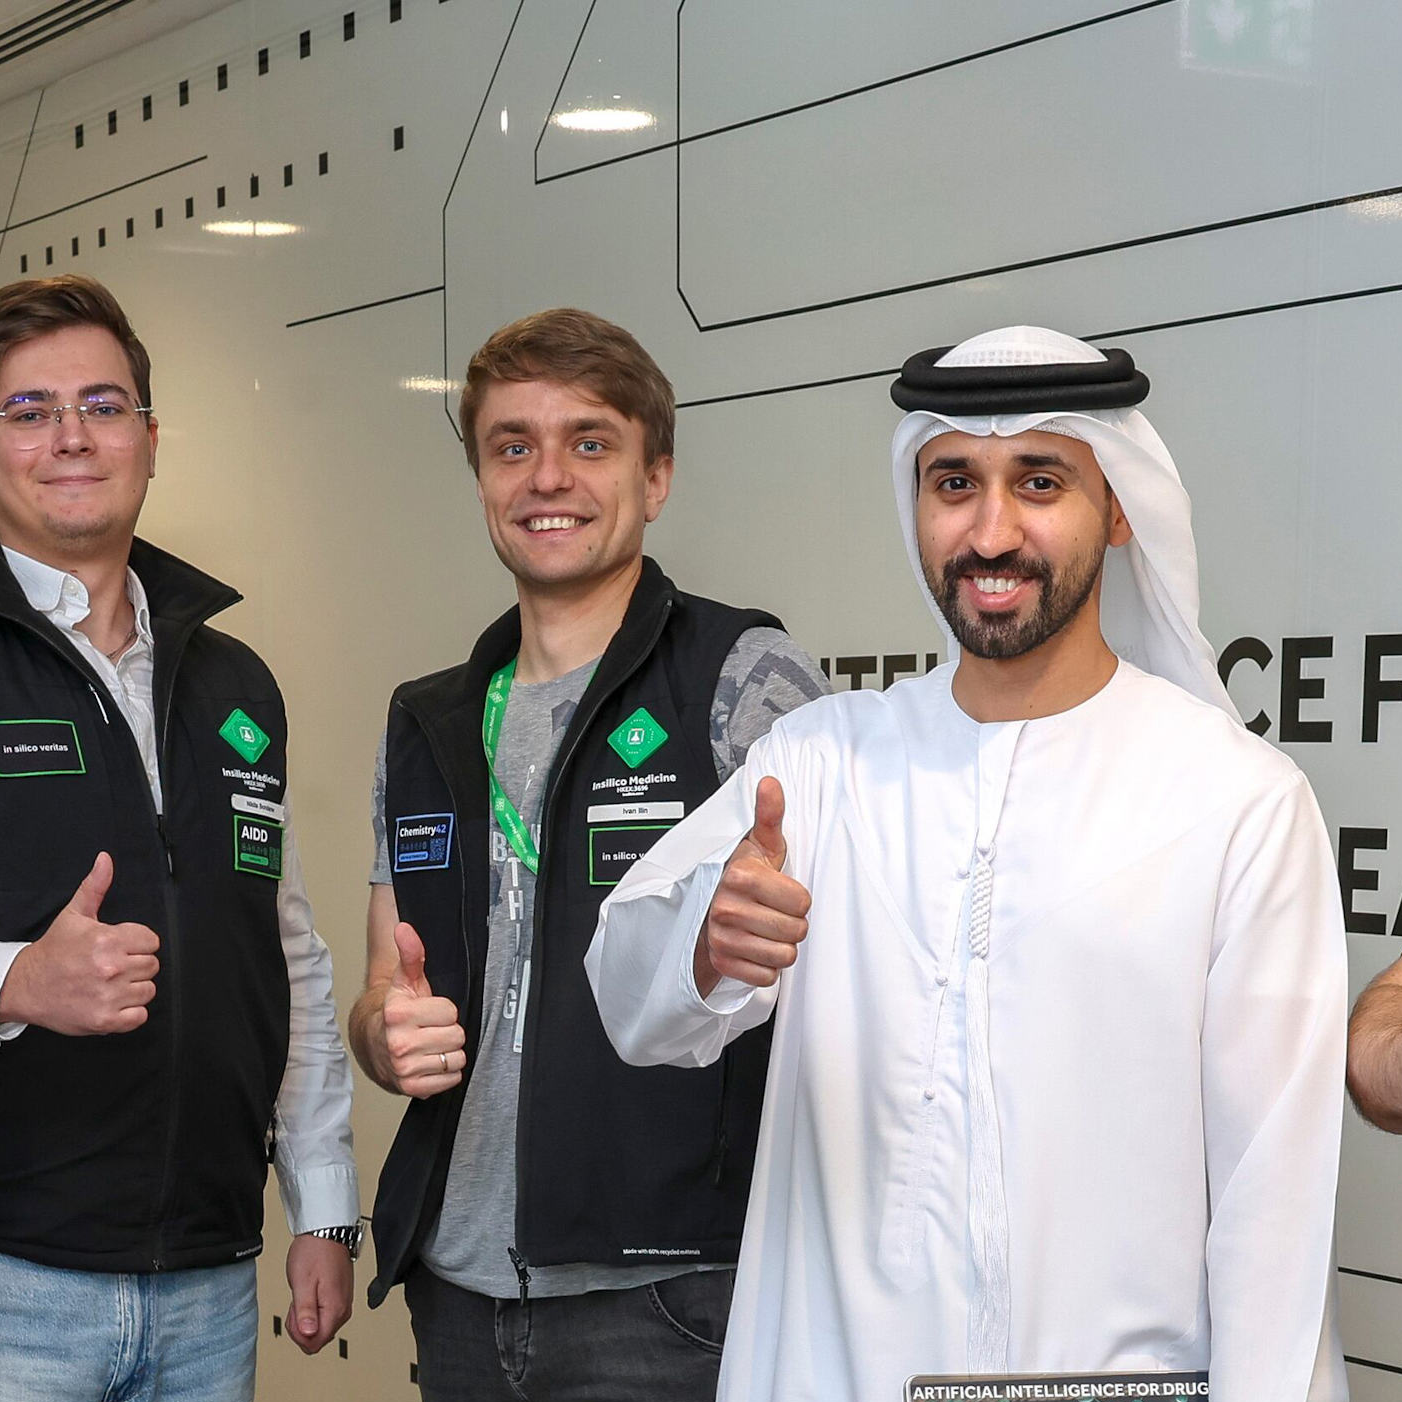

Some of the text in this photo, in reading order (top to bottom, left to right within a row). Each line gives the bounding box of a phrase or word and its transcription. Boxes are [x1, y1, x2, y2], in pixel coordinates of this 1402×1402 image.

[3, 743, 69, 753] in silico veritas
[222, 768, 251, 780] Insilico
[592, 773, 677, 791] Insilico Medicine
[241, 825, 268, 843] AIDD
[399, 823, 447, 838] Chemistry42
[602, 852, 611, 861] in
[612, 851, 637, 861] silico
[913, 1382, 1209, 1400] ARTIFICIAL INTELLIGENCE FOR DRUG
